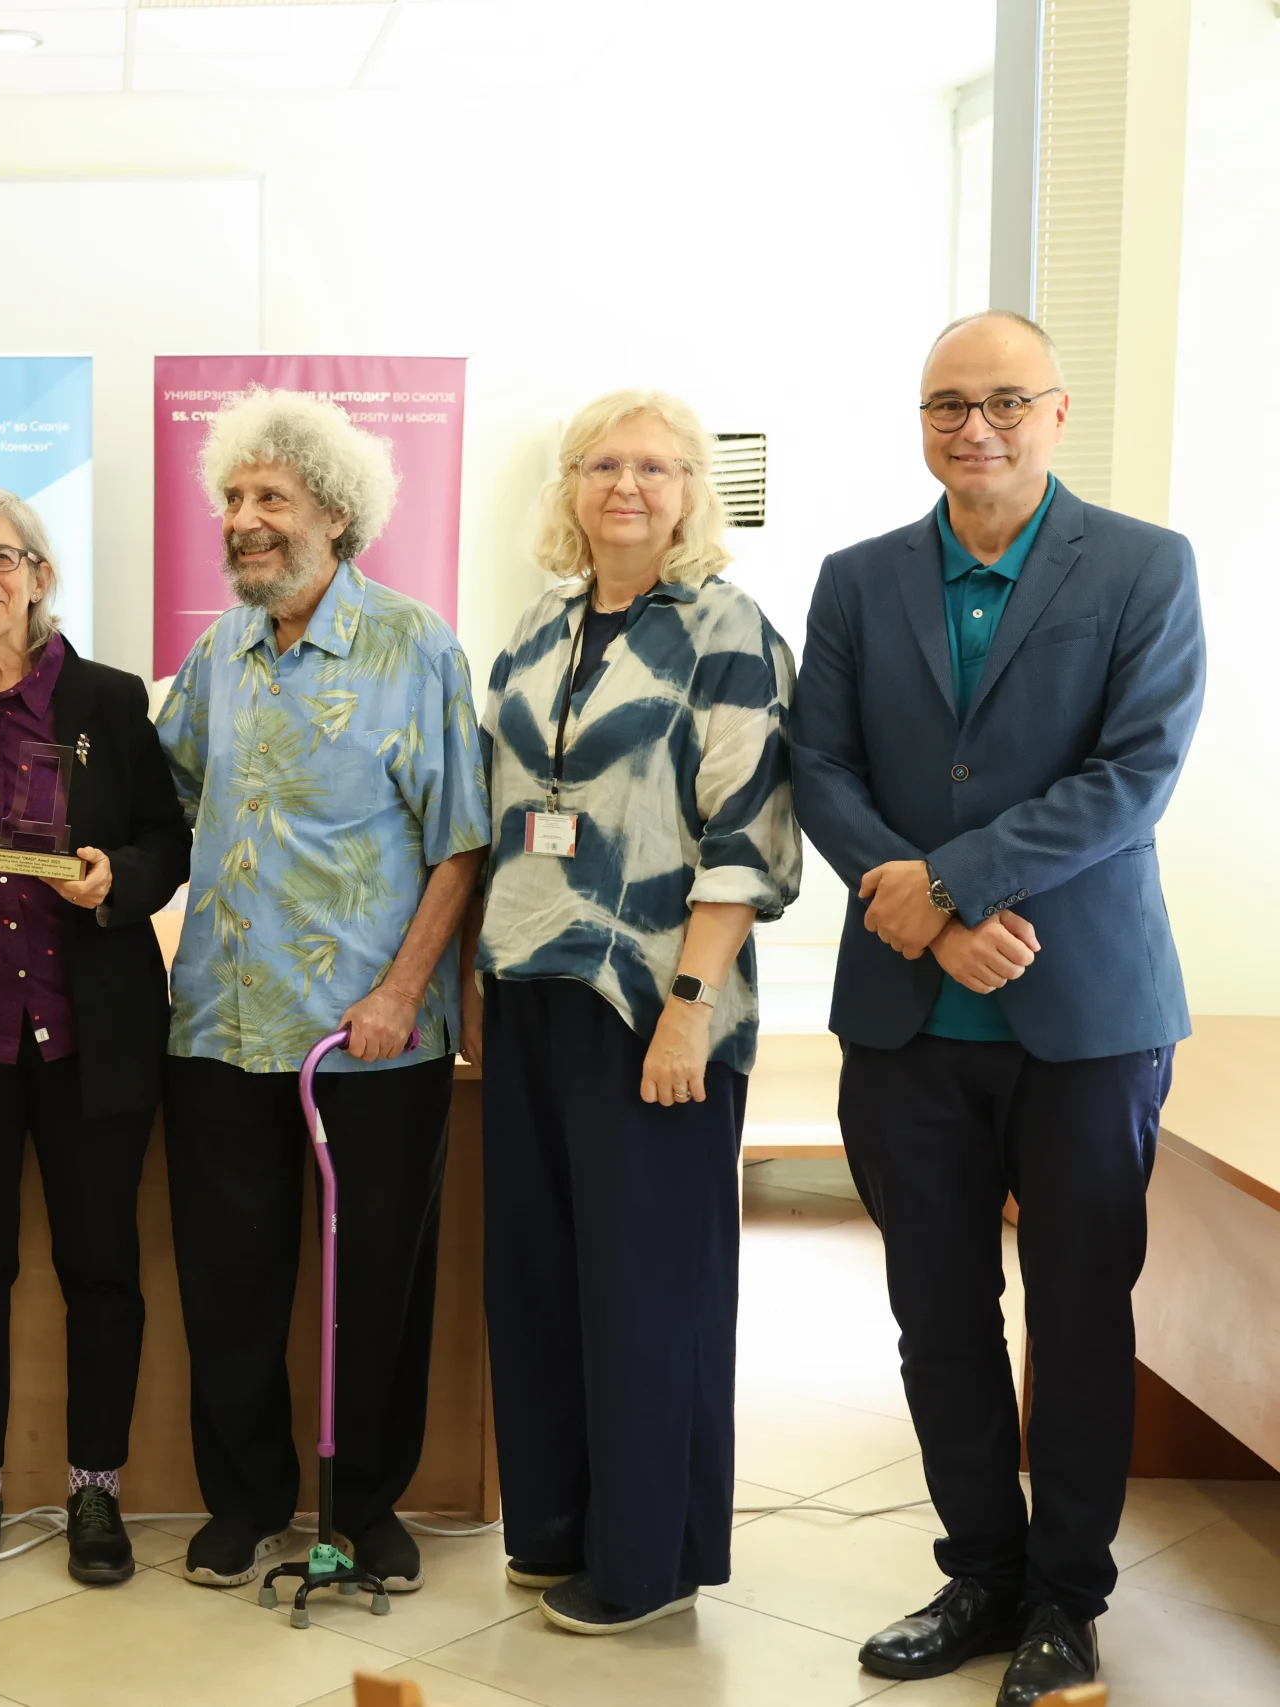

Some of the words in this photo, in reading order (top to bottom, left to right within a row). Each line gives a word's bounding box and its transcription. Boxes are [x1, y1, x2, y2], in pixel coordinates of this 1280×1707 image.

[392, 391, 411, 403] ВО
[411, 391, 457, 403] СКОПЈЕ
[171, 410, 190, 422] SS.
[191, 410, 216, 422] CYR
[391, 412, 404, 423] IN
[405, 412, 449, 424] SKOPJE
[14, 423, 28, 433] во
[30, 421, 71, 435] Скопје
